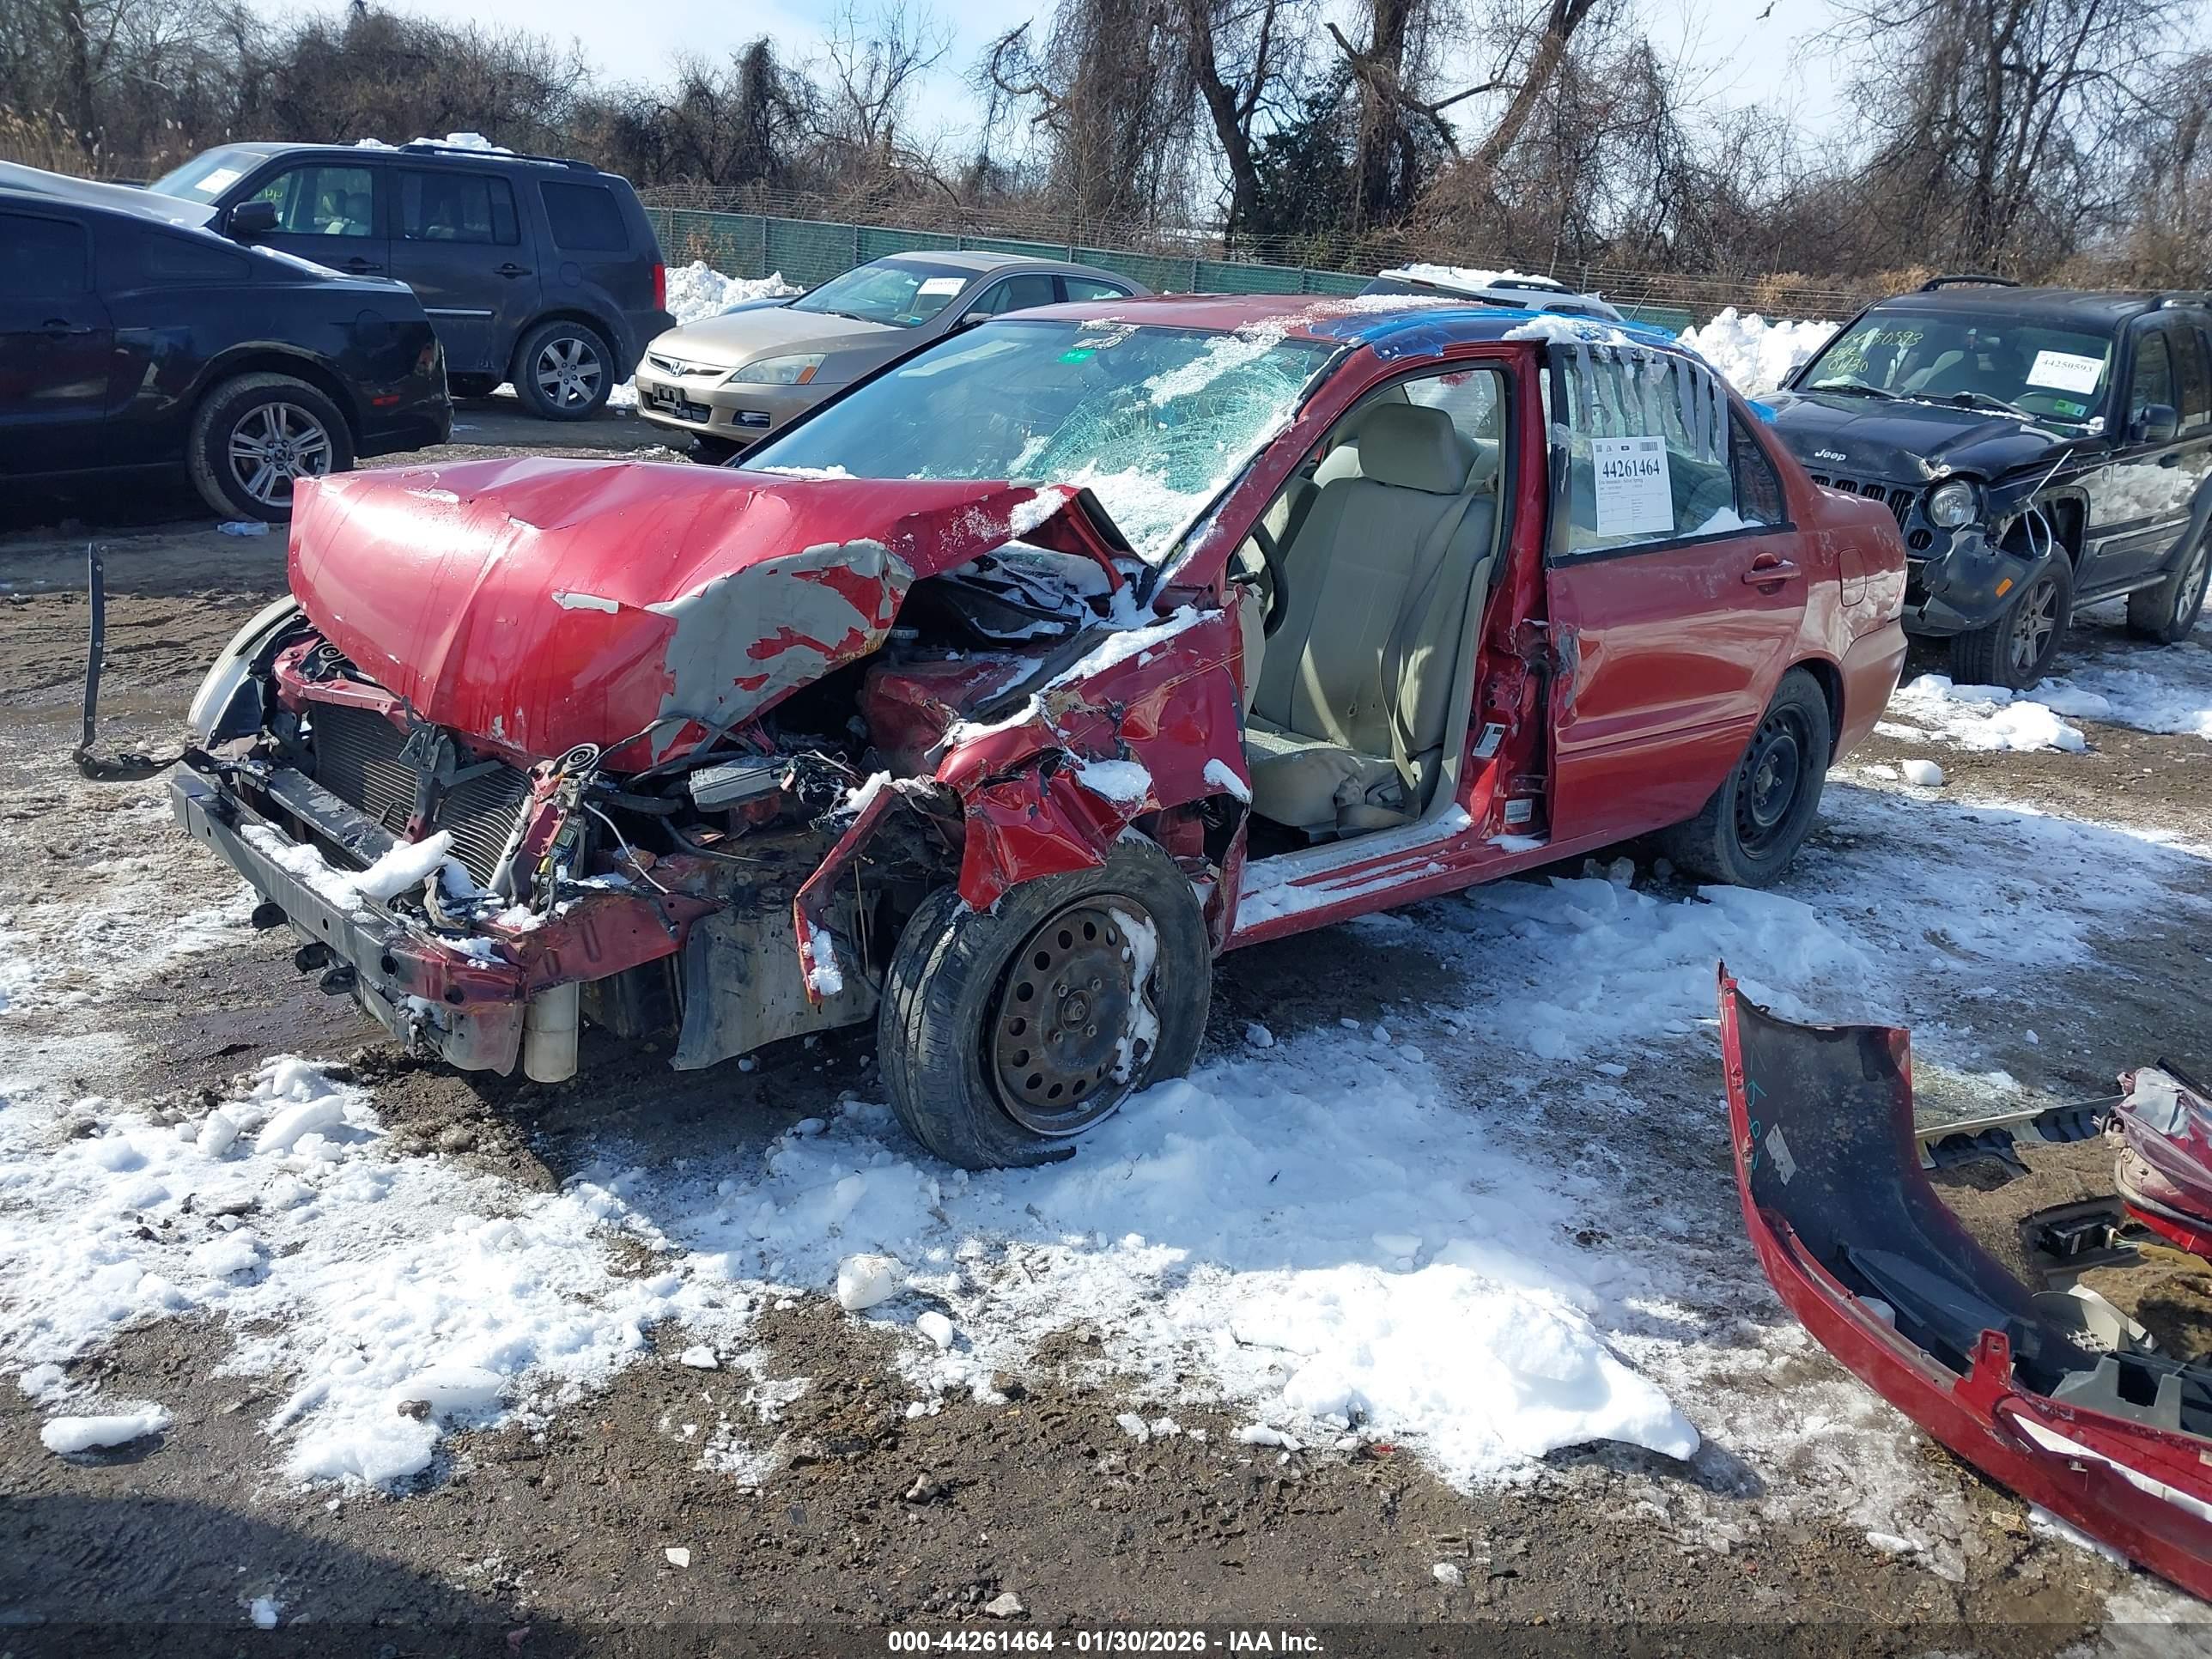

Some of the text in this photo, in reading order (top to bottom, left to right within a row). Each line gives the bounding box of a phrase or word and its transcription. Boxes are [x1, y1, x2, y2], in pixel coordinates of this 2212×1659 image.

[1842, 331, 1924, 346] 4450593
[1814, 448, 1847, 461] Jeep
[1602, 458, 1661, 478] 44261464
